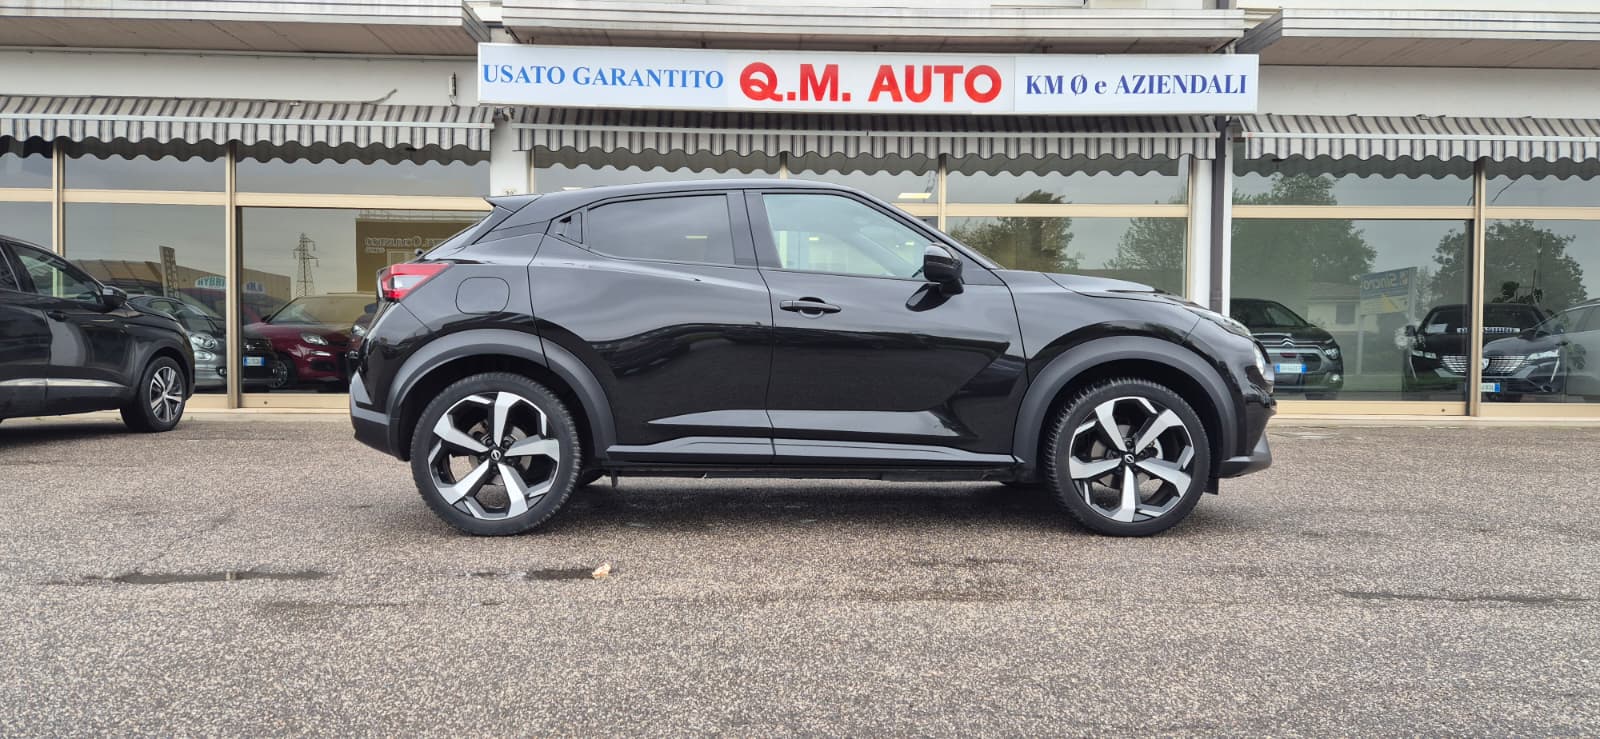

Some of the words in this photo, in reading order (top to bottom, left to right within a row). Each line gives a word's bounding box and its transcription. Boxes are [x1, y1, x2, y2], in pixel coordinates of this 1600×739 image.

[482, 64, 567, 85] USATO
[572, 66, 725, 90] GARANTITO
[739, 61, 852, 104] Q.M.
[867, 64, 1003, 104] AUTO
[1025, 75, 1065, 96] KM
[1094, 80, 1108, 96] e
[1114, 74, 1248, 95] AZIENDALI
